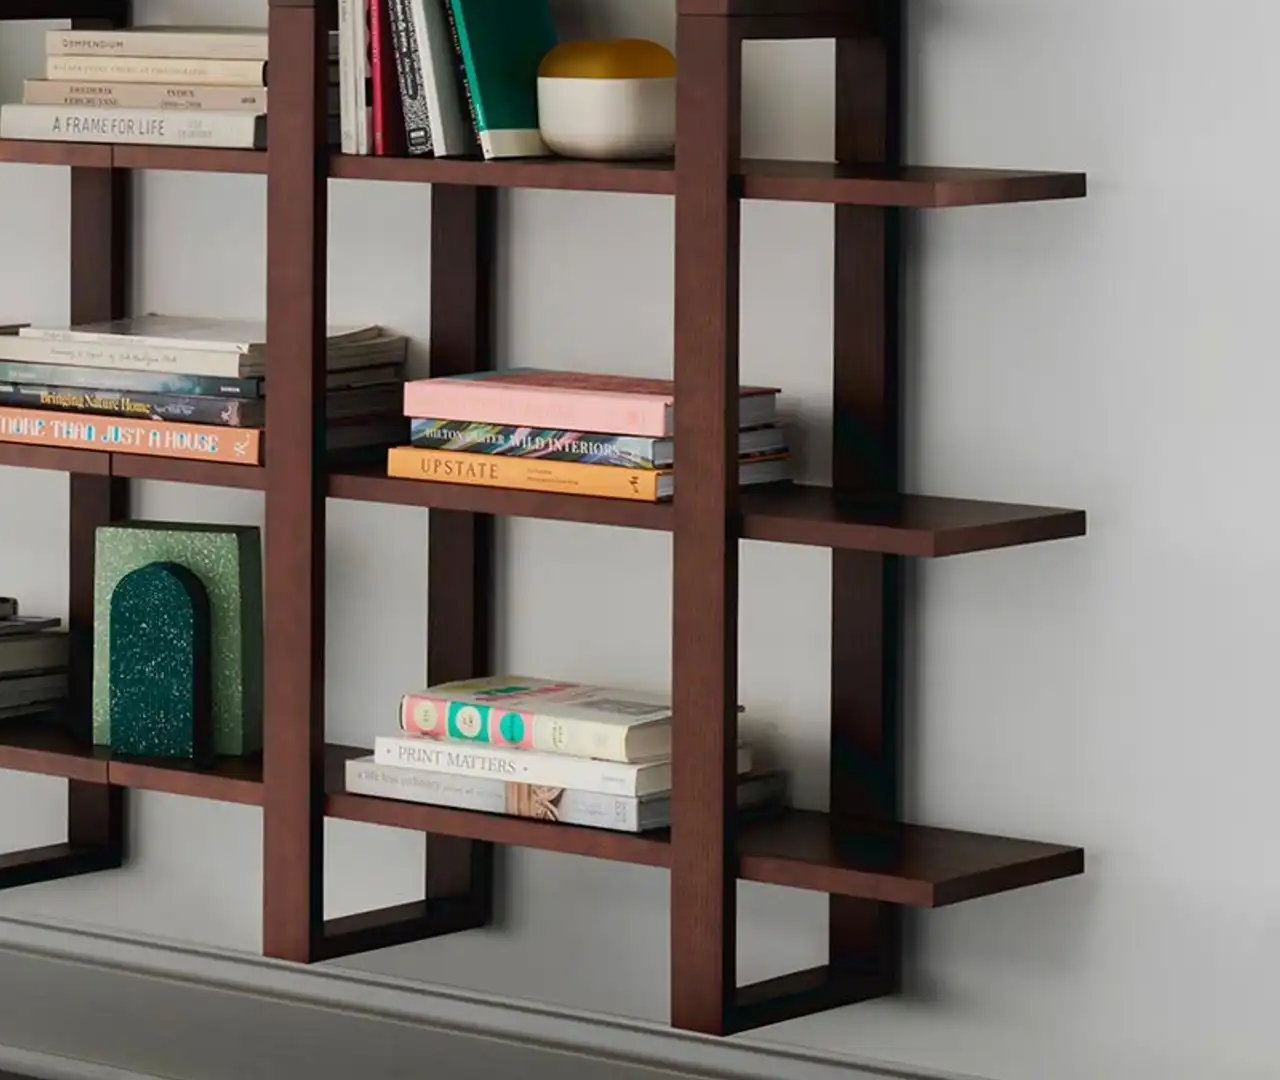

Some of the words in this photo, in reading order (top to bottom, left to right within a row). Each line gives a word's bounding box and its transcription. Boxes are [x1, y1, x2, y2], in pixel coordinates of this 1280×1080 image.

[52, 116, 62, 132] A
[65, 117, 107, 134] FRAME
[110, 118, 135, 135] FOR
[138, 119, 165, 136] LIFE
[50, 419, 96, 442] THAN
[101, 424, 145, 445] JUST
[148, 430, 161, 448] A
[165, 432, 219, 453] HOUSE
[509, 434, 545, 451] WILD
[546, 437, 621, 457] INTERIORS
[420, 457, 499, 480] UPSTATE
[398, 745, 441, 766] PRINT
[445, 751, 517, 773] MATTERS
